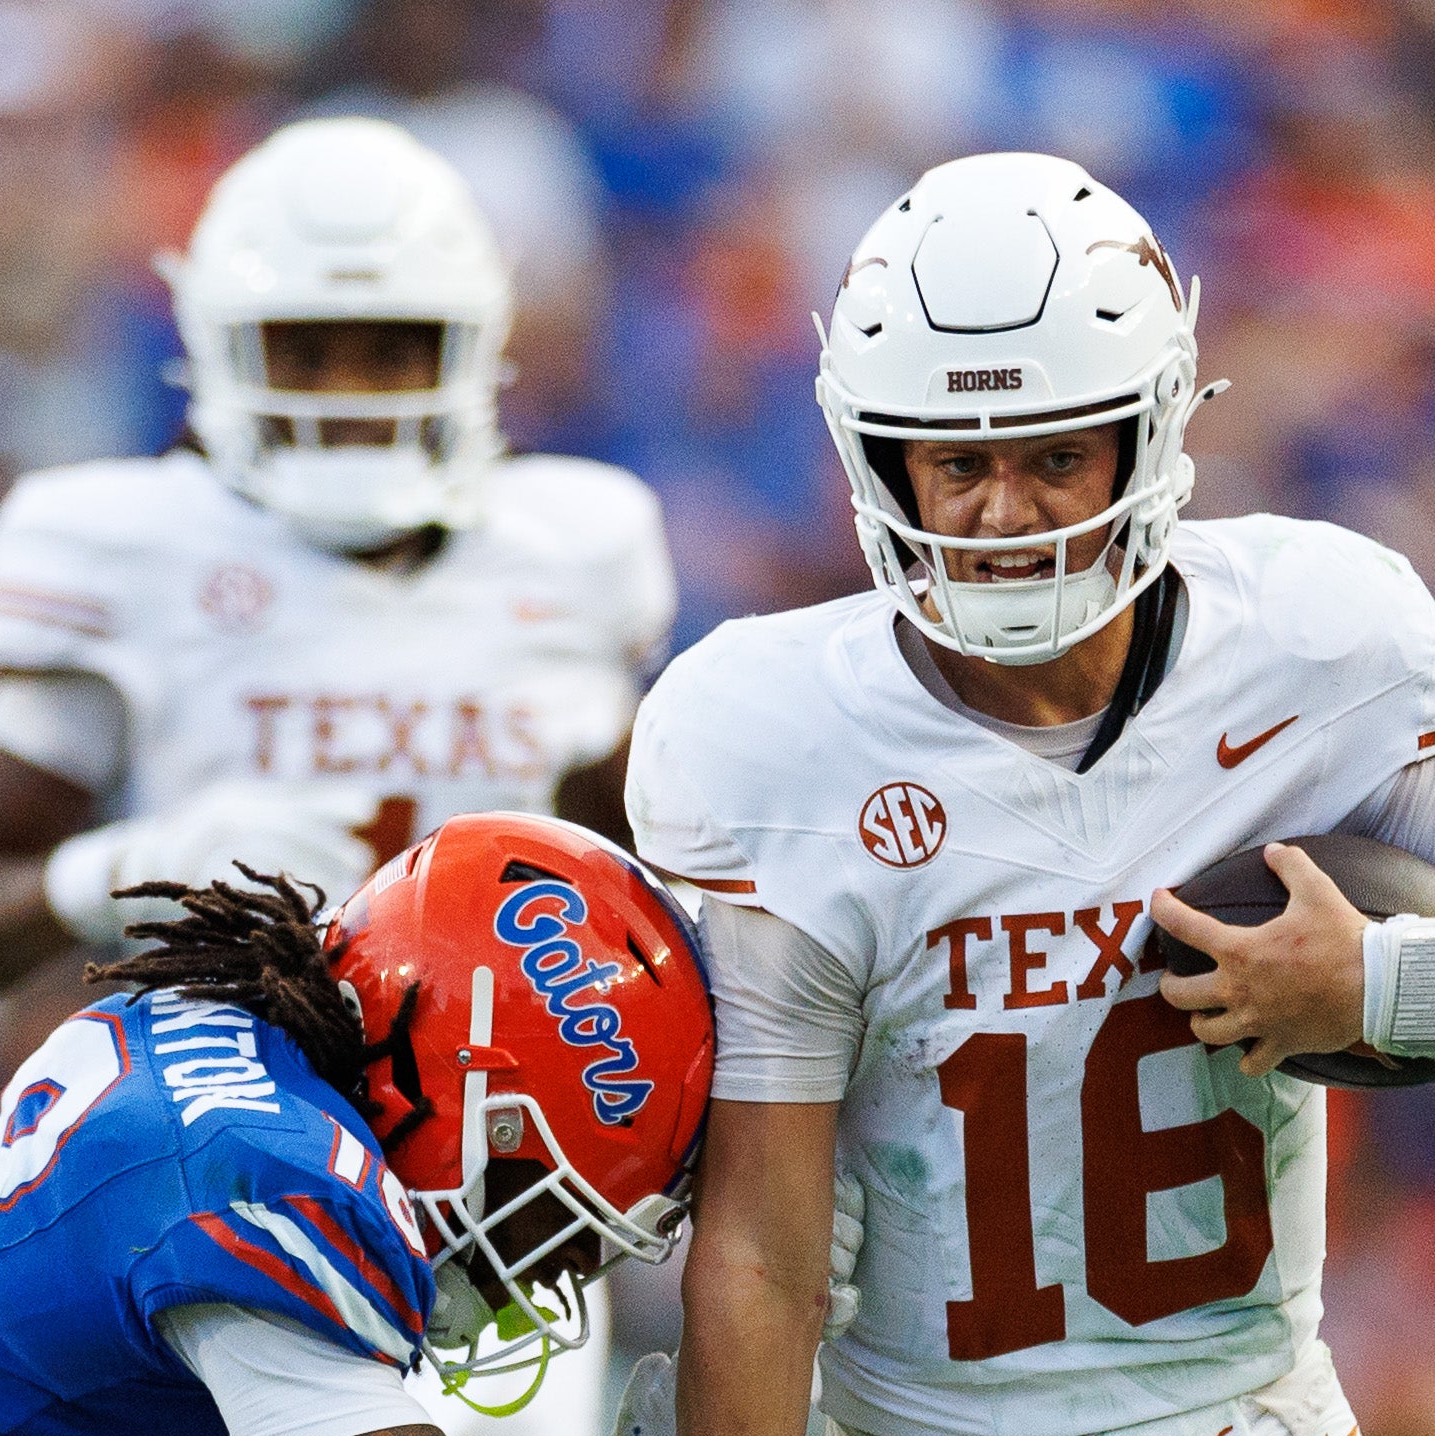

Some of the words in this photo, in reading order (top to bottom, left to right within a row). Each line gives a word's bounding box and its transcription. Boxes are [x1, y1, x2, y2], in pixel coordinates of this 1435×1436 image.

[947, 369, 1022, 392] HORNS
[242, 692, 548, 779] TEXAS
[861, 784, 944, 865] SEC
[493, 879, 654, 1126] Gators
[926, 899, 1166, 1010] TEX
[937, 998, 1274, 1361] 16
